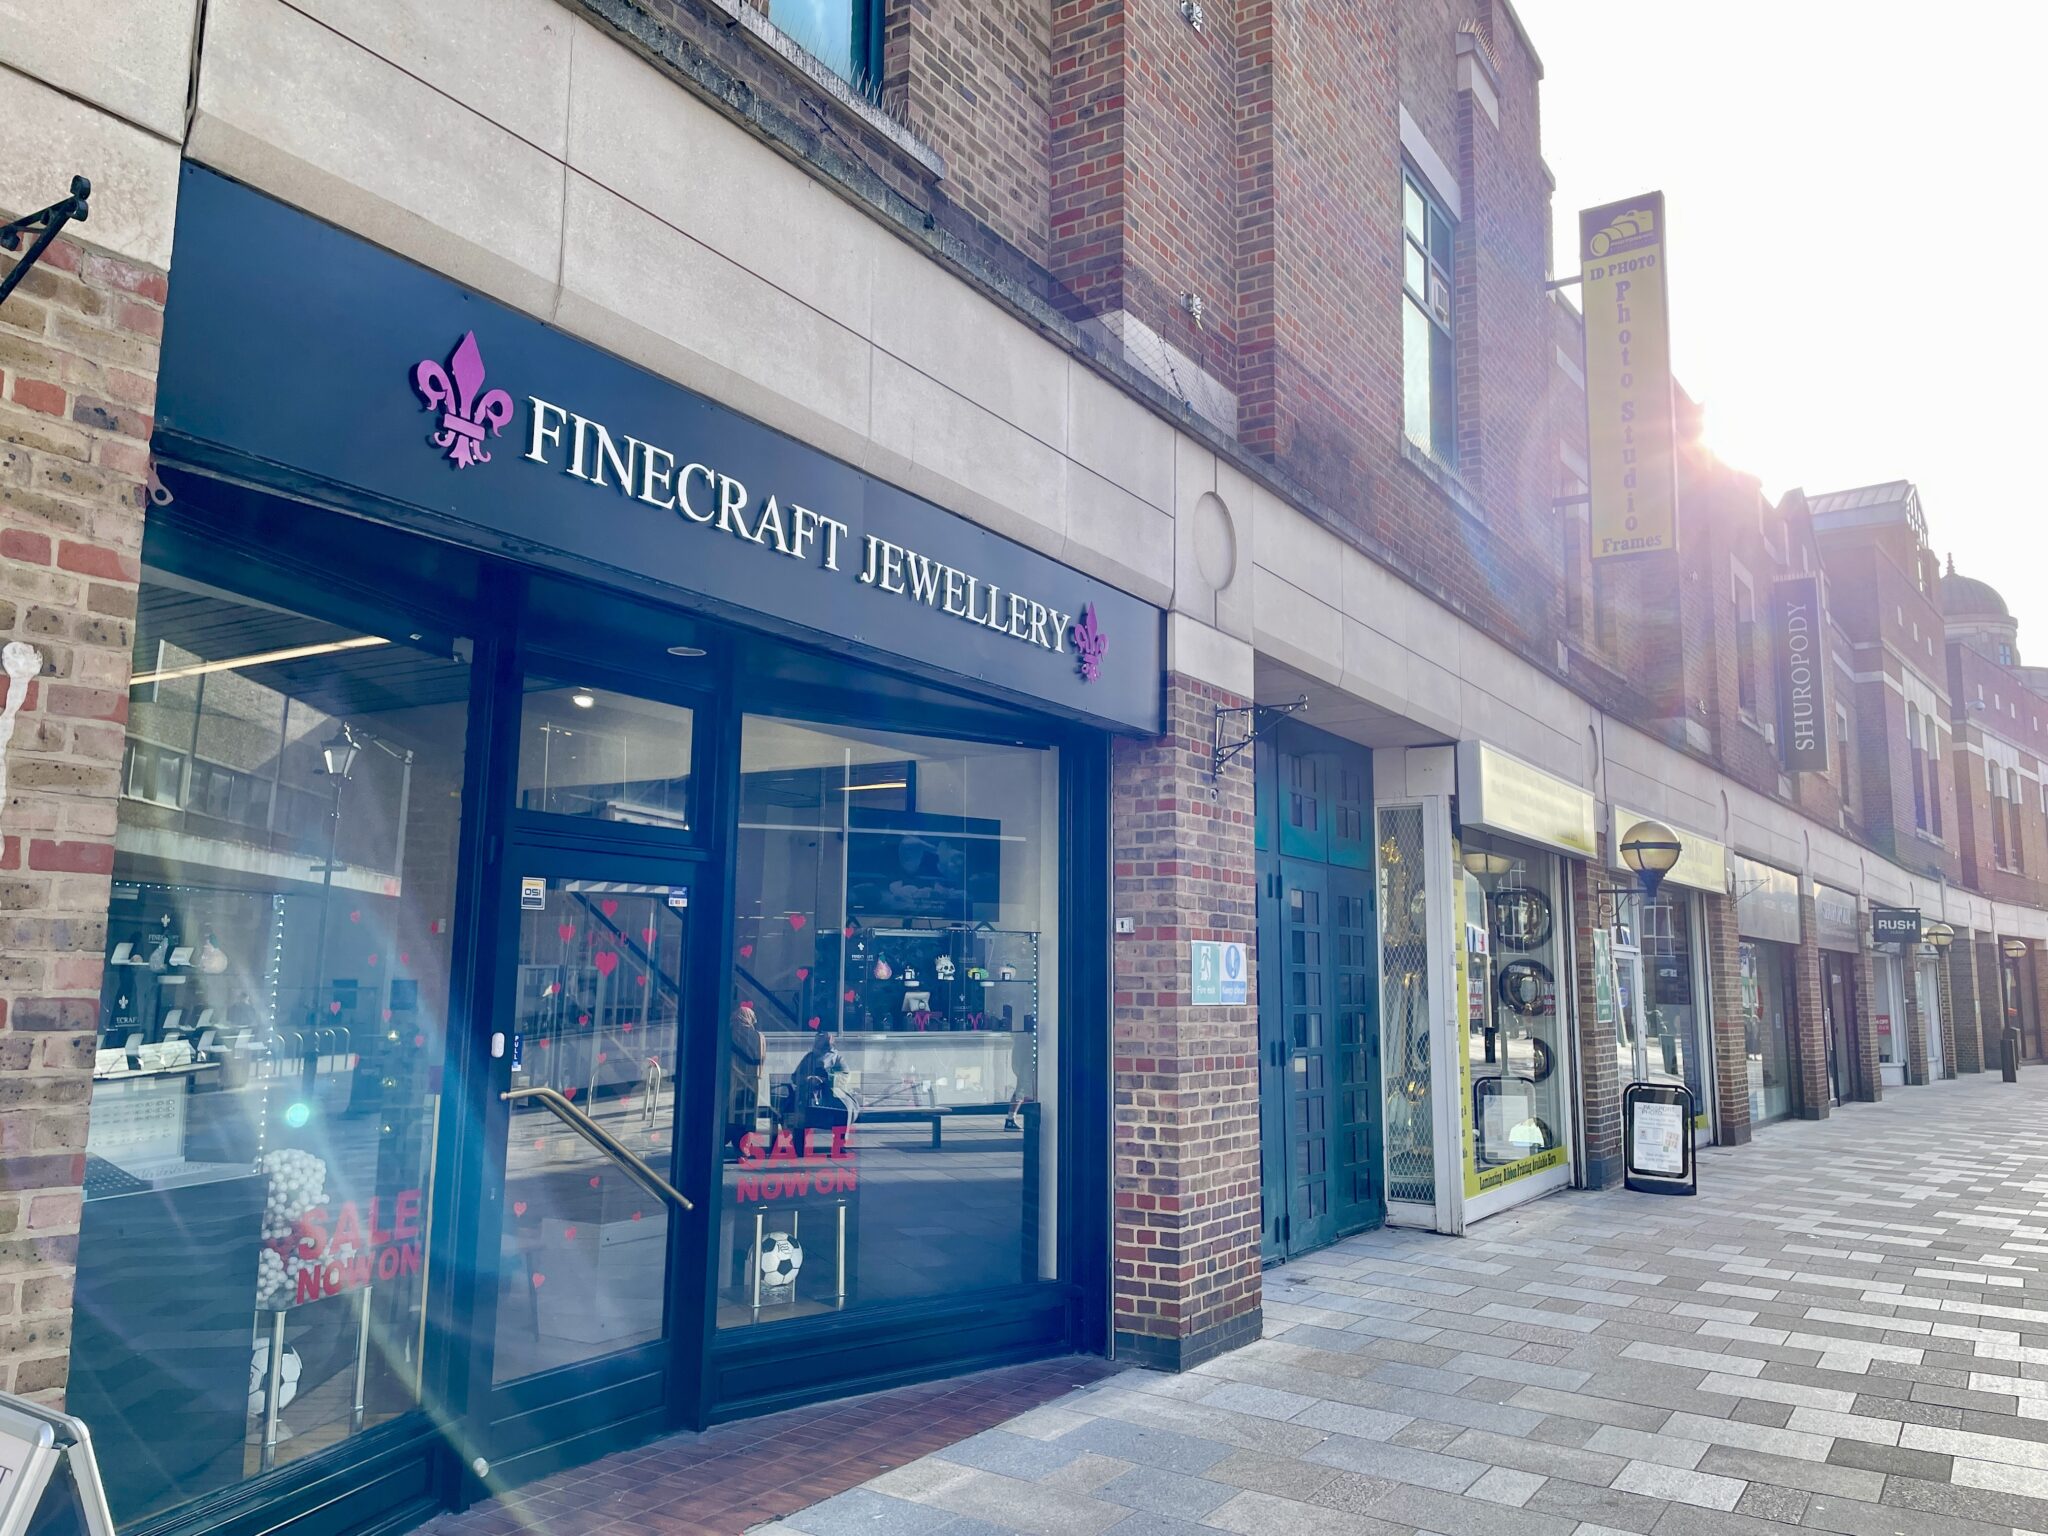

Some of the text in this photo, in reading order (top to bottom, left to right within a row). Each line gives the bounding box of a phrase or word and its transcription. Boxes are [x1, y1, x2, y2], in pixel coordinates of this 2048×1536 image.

[1590, 254, 1656, 281] ID PHOTO
[1615, 280, 1638, 532] Photo Studio
[525, 397, 1071, 654] FINECRAFT JEWELLERY
[1602, 534, 1662, 553] Frames
[1787, 601, 1815, 751] SHUROPODY
[1878, 919, 1917, 930] RUSH
[738, 1126, 856, 1170] SALE
[736, 1167, 857, 1203] NOW ON
[298, 1189, 422, 1260] SALE
[296, 1243, 422, 1304] NOW ON
